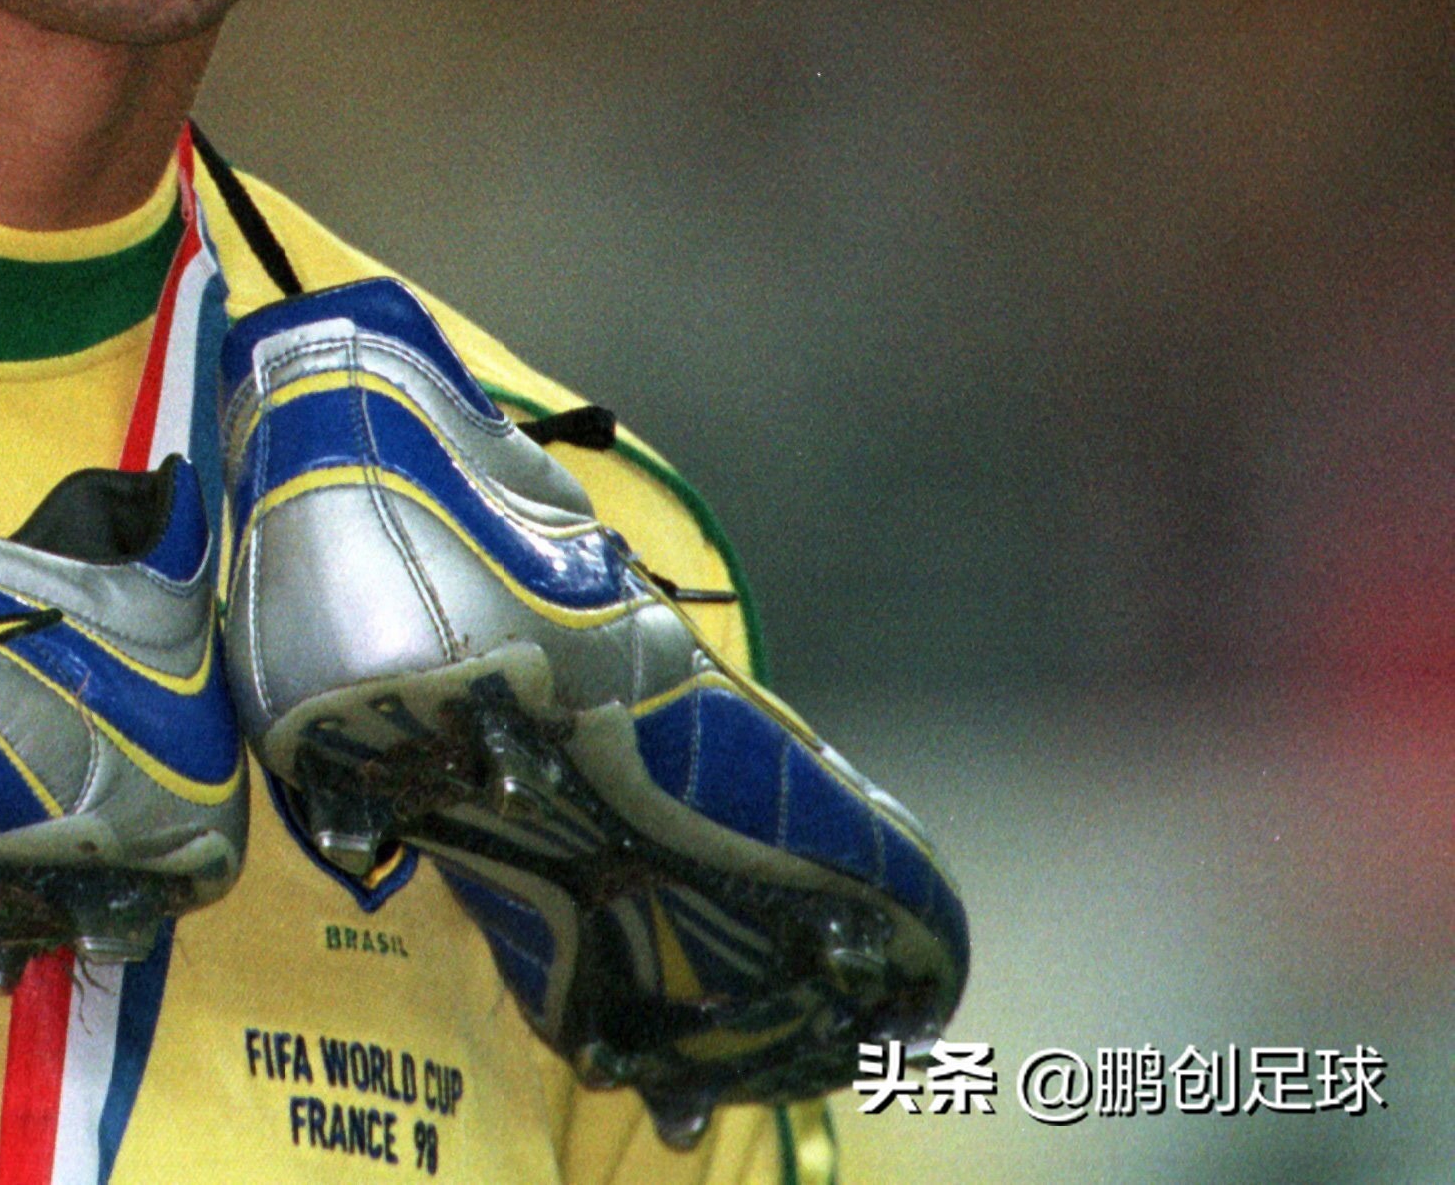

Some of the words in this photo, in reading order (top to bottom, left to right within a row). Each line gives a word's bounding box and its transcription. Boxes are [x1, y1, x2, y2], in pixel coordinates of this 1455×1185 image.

[325, 925, 408, 958] BRASIL
[245, 1028, 313, 1084] FIFA
[320, 1035, 417, 1105] WORLD
[423, 1059, 463, 1117] CUP
[289, 1095, 399, 1165] FRANCE
[413, 1119, 438, 1176] 98
